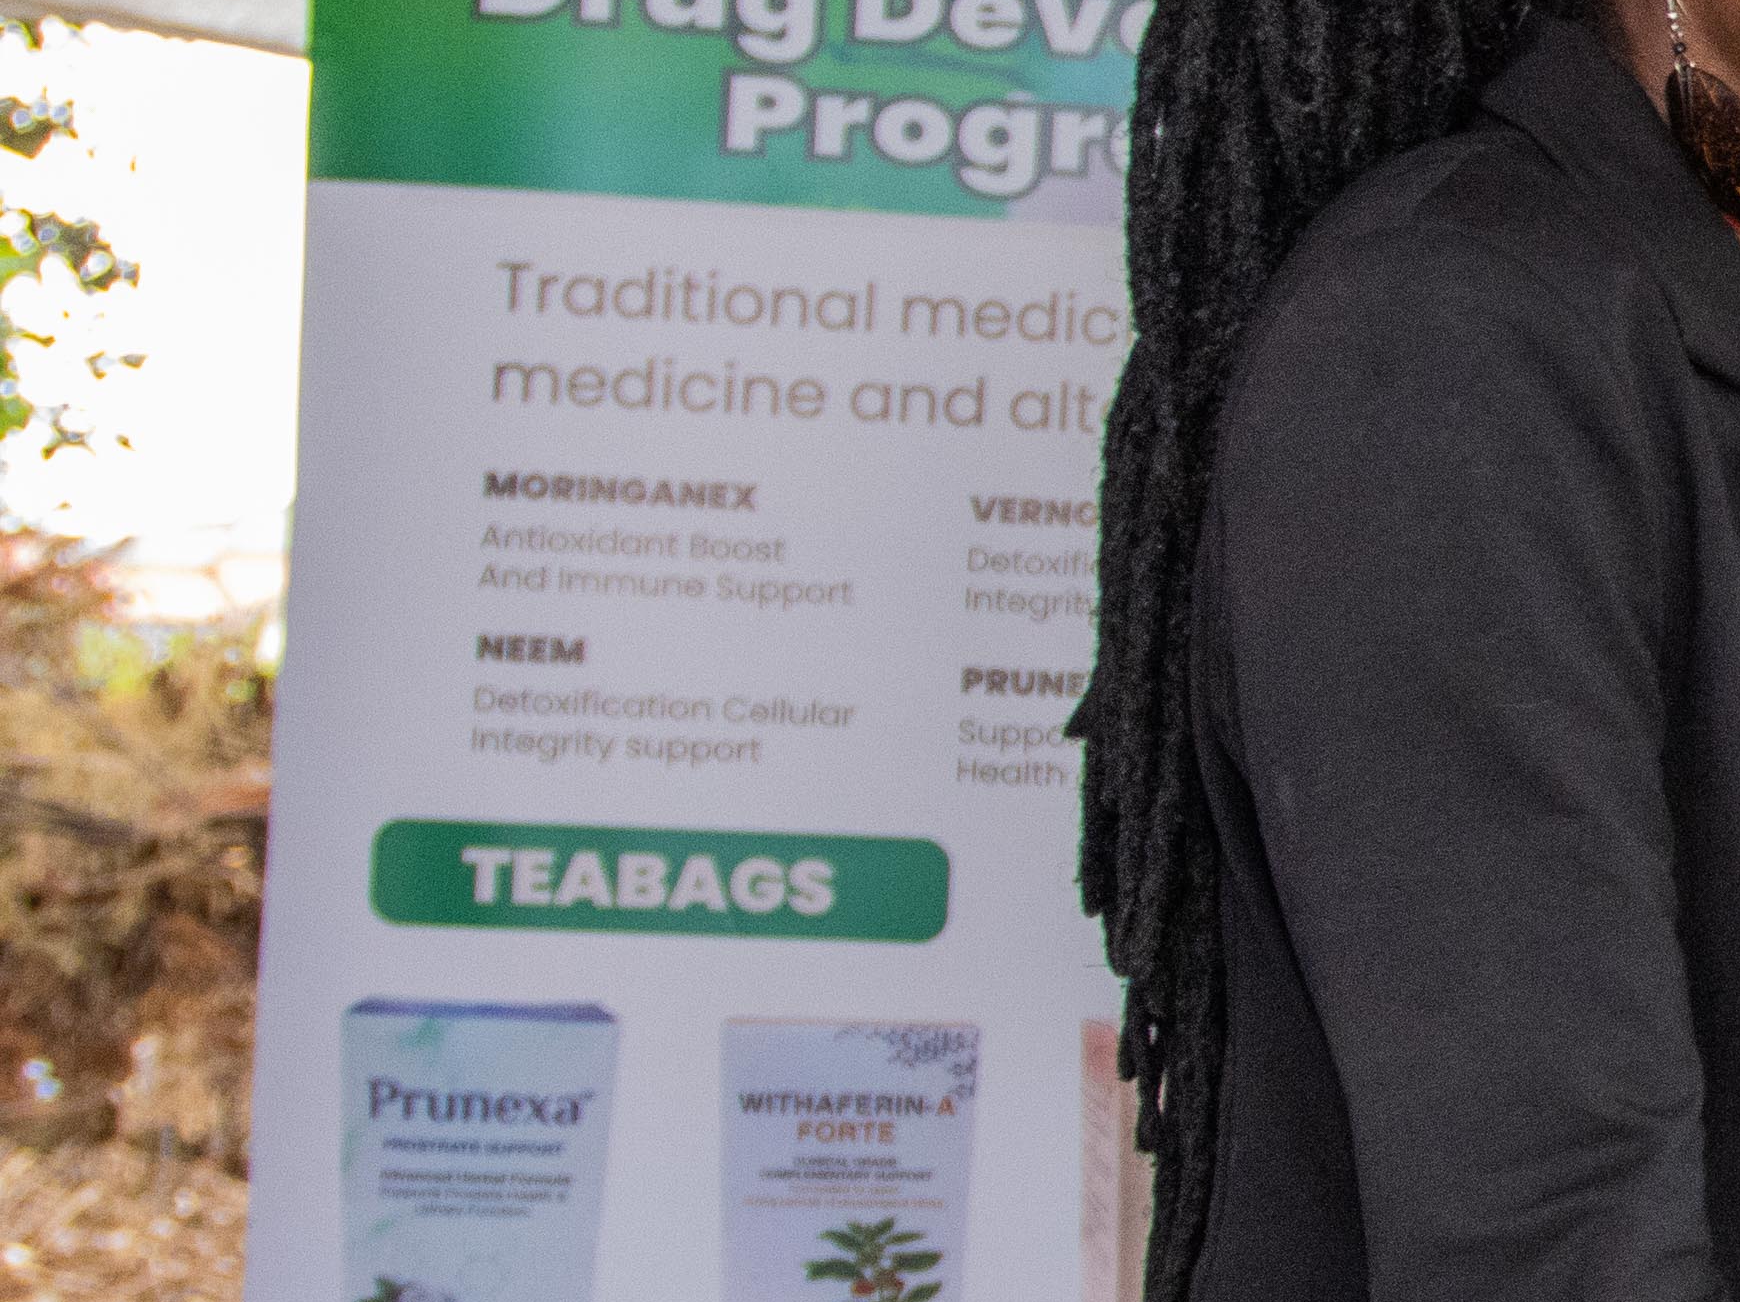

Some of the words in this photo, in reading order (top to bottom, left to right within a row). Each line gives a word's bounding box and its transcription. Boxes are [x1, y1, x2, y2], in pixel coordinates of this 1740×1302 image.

[725, 74, 1129, 197] Progr
[495, 261, 878, 334] Traditional
[899, 291, 1133, 345] medic
[492, 357, 827, 421] medicine
[850, 371, 985, 427] and
[1010, 381, 1112, 435] alt
[482, 470, 758, 512] MORINGANEX
[480, 521, 678, 560] Antioxidant
[689, 530, 786, 565] Boost
[478, 561, 549, 596] And
[557, 566, 707, 602] Immune
[714, 574, 853, 611] Support
[476, 633, 586, 667] NEEM
[961, 666, 1088, 697] PRUNE
[472, 684, 713, 723] Detoxification
[723, 693, 855, 730] Cellular
[470, 726, 618, 765] Integrity
[627, 733, 760, 769] support
[956, 755, 1067, 788] Health
[461, 846, 838, 915] TEABAGS
[739, 1092, 956, 1117] WITHAFERIN-A
[797, 1121, 896, 1145] FORTE
